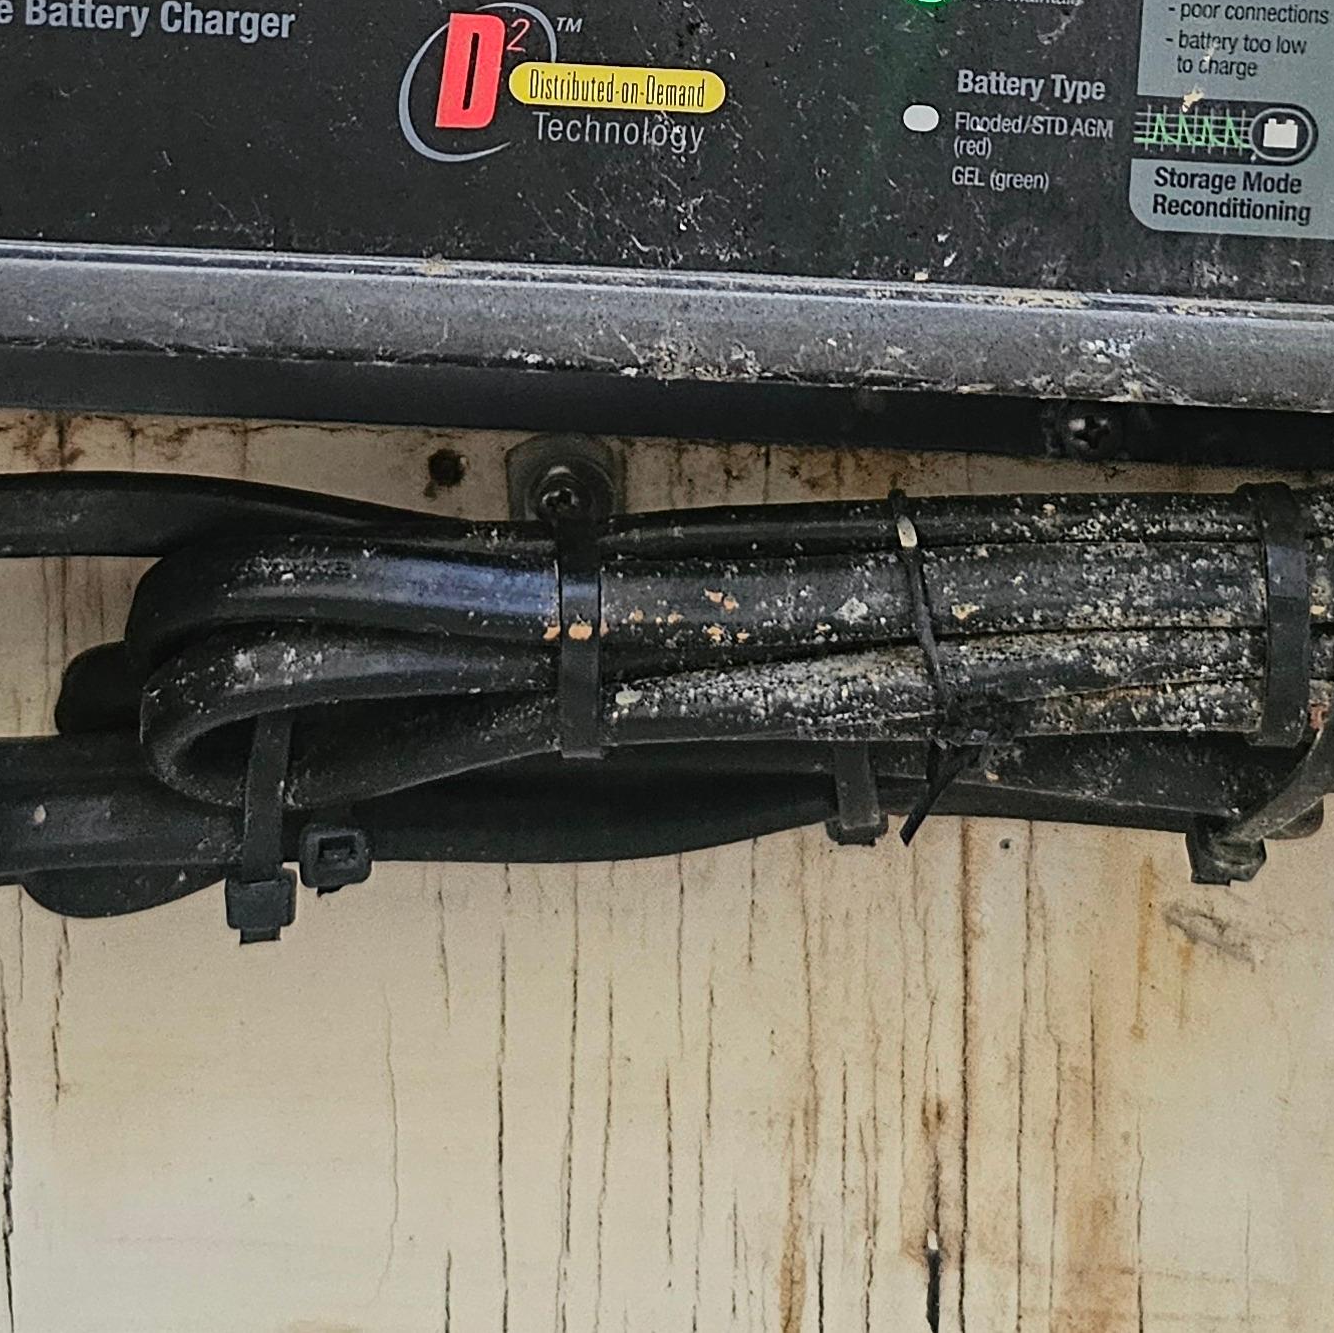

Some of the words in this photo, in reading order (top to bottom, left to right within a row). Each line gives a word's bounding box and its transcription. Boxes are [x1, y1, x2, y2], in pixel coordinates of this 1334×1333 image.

[160, 0, 297, 43] Charger
[1180, 2, 1220, 22] poor
[1225, 5, 1329, 24] connections
[1178, 31, 1238, 57] battery
[1243, 35, 1271, 53] too
[1275, 35, 1307, 54] low
[1177, 57, 1192, 74] to
[1200, 57, 1258, 78] charge
[530, 69, 706, 107] Distributed-on-Demand
[958, 69, 1045, 102] Battery
[1051, 74, 1106, 104] Type
[532, 111, 705, 154] Technology
[955, 111, 1067, 135] Flooded/STD
[1070, 119, 1114, 138] AGM
[954, 136, 992, 159] (red)
[952, 166, 985, 186] GEL
[990, 170, 1049, 192] (green)
[1154, 167, 1236, 195] Storage
[1243, 171, 1302, 194] Mode
[1152, 194, 1311, 226] Reconditioning
